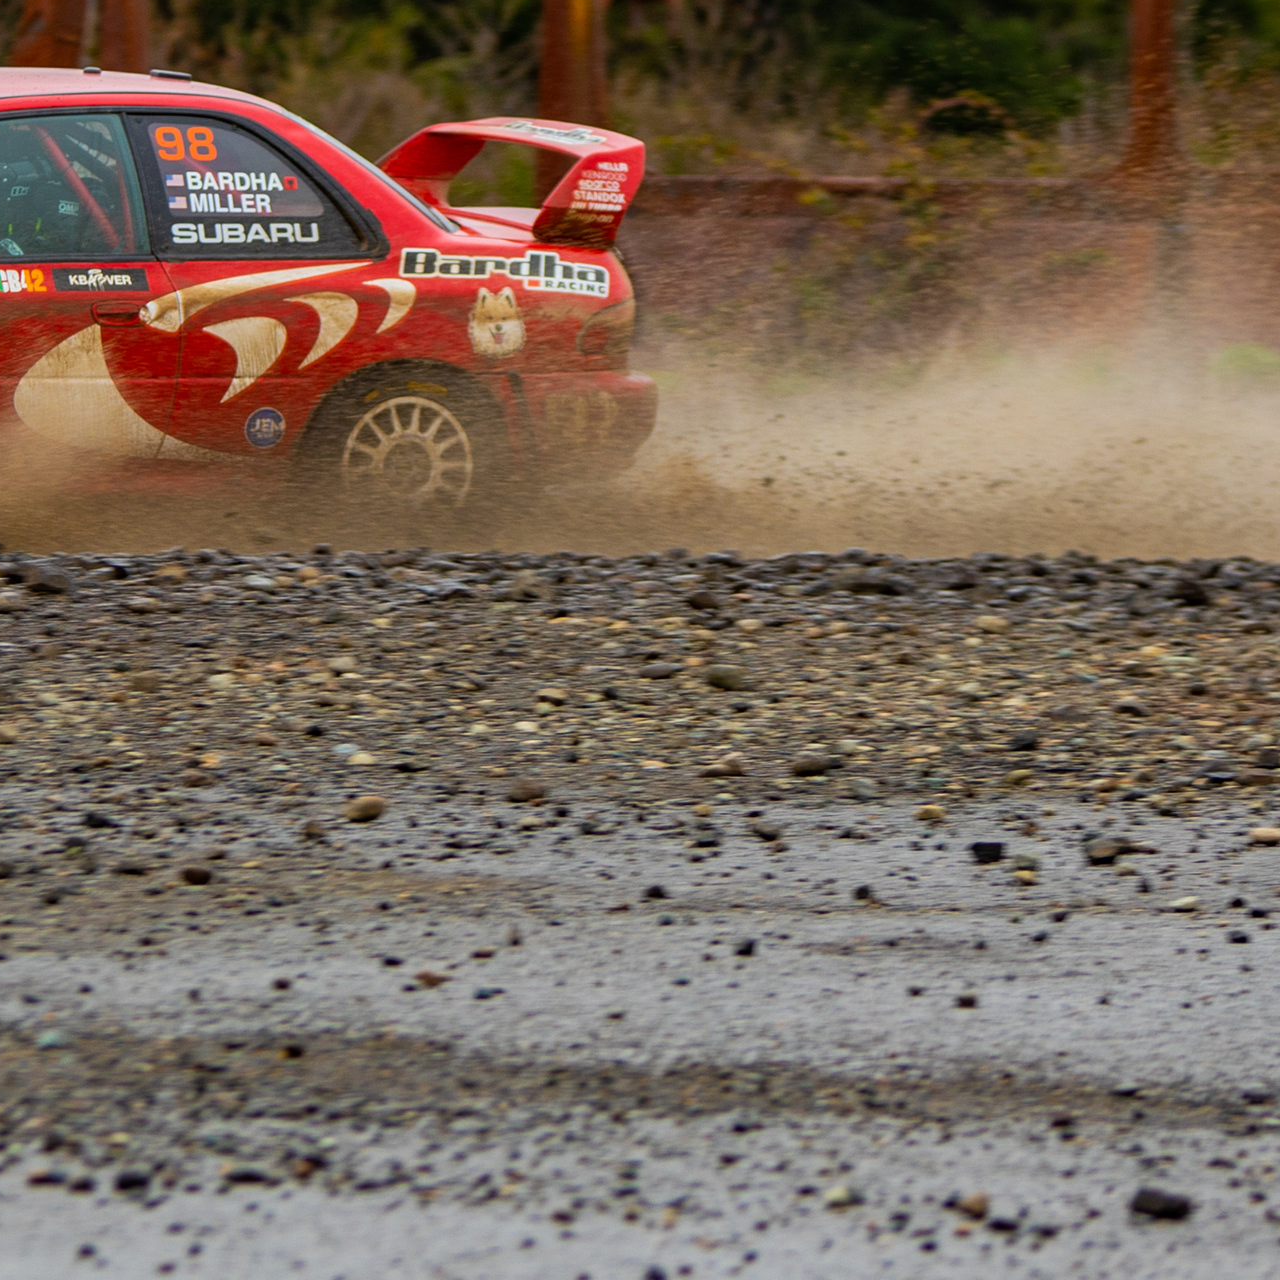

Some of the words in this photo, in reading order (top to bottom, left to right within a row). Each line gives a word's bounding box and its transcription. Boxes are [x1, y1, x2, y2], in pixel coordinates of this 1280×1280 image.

[155, 126, 218, 161] 98
[186, 171, 284, 191] BARDHA
[189, 193, 272, 213] MILLER
[573, 190, 626, 203] STANDOX
[171, 223, 319, 243] SUBARU
[403, 250, 607, 284] Bardha
[545, 280, 607, 295] RACING
